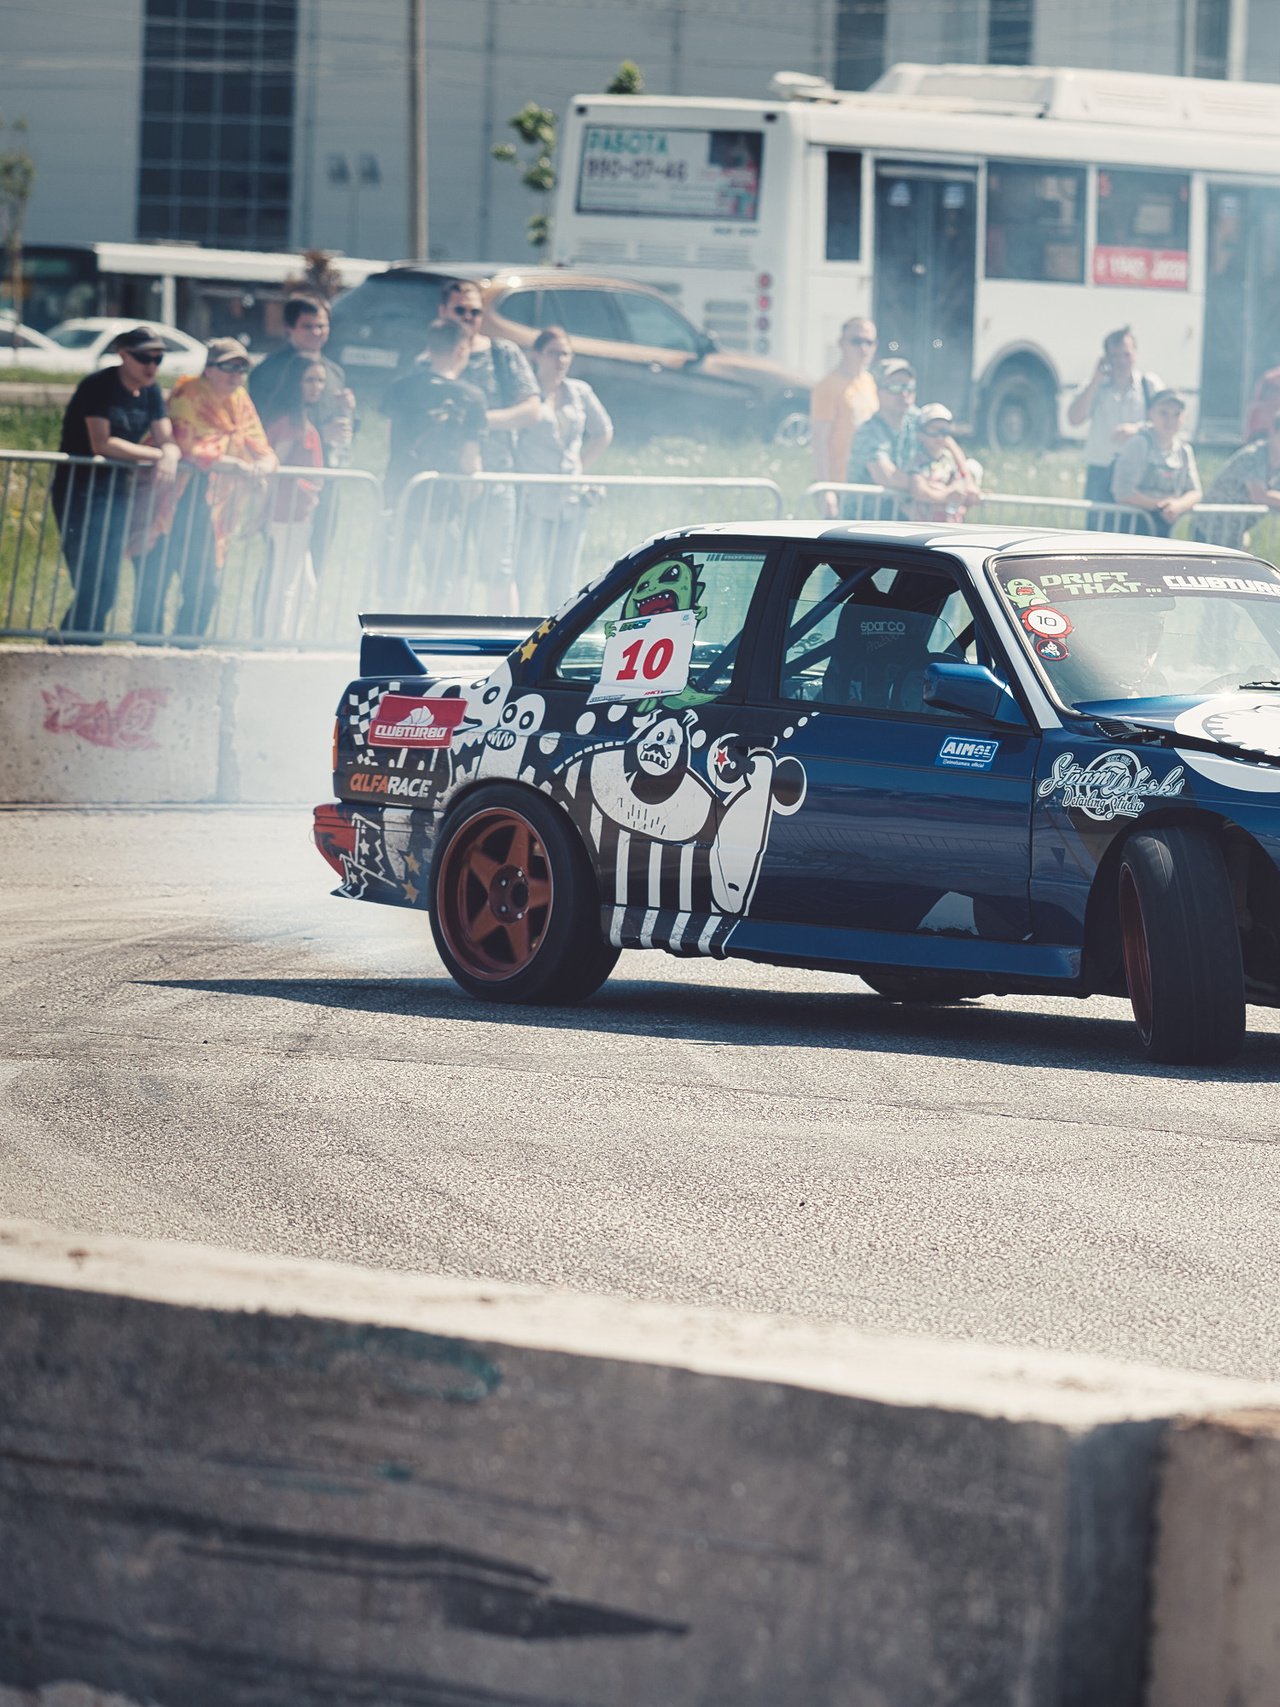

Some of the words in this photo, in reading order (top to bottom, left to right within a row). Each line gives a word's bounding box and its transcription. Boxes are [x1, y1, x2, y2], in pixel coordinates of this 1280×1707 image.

[1040, 571, 1128, 588] DRIFT
[860, 620, 906, 635] sparco
[1036, 614, 1057, 628] 10
[616, 638, 674, 681] 10
[374, 724, 448, 741] CLUBTURBO
[943, 741, 992, 758] AIMOL
